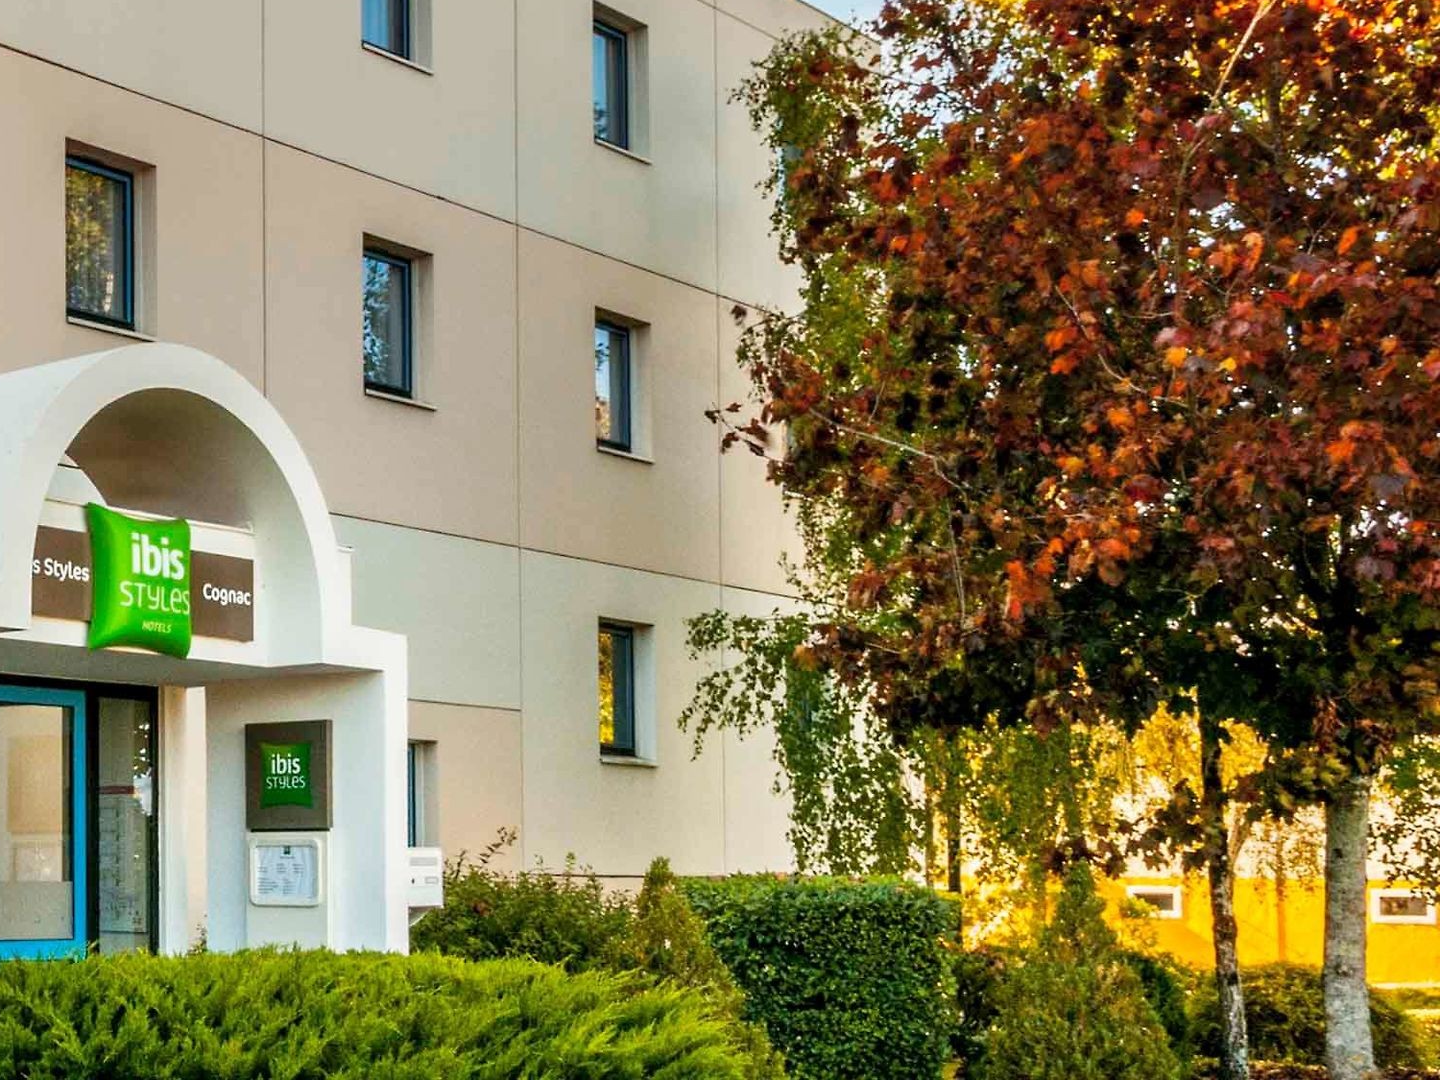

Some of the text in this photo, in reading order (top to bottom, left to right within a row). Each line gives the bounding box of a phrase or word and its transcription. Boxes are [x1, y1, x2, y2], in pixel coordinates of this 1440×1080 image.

[131, 533, 185, 580] ibis
[44, 558, 91, 583] Styles
[203, 583, 252, 607] Cognac
[142, 621, 172, 634] HOTELS
[271, 753, 301, 775] ibis
